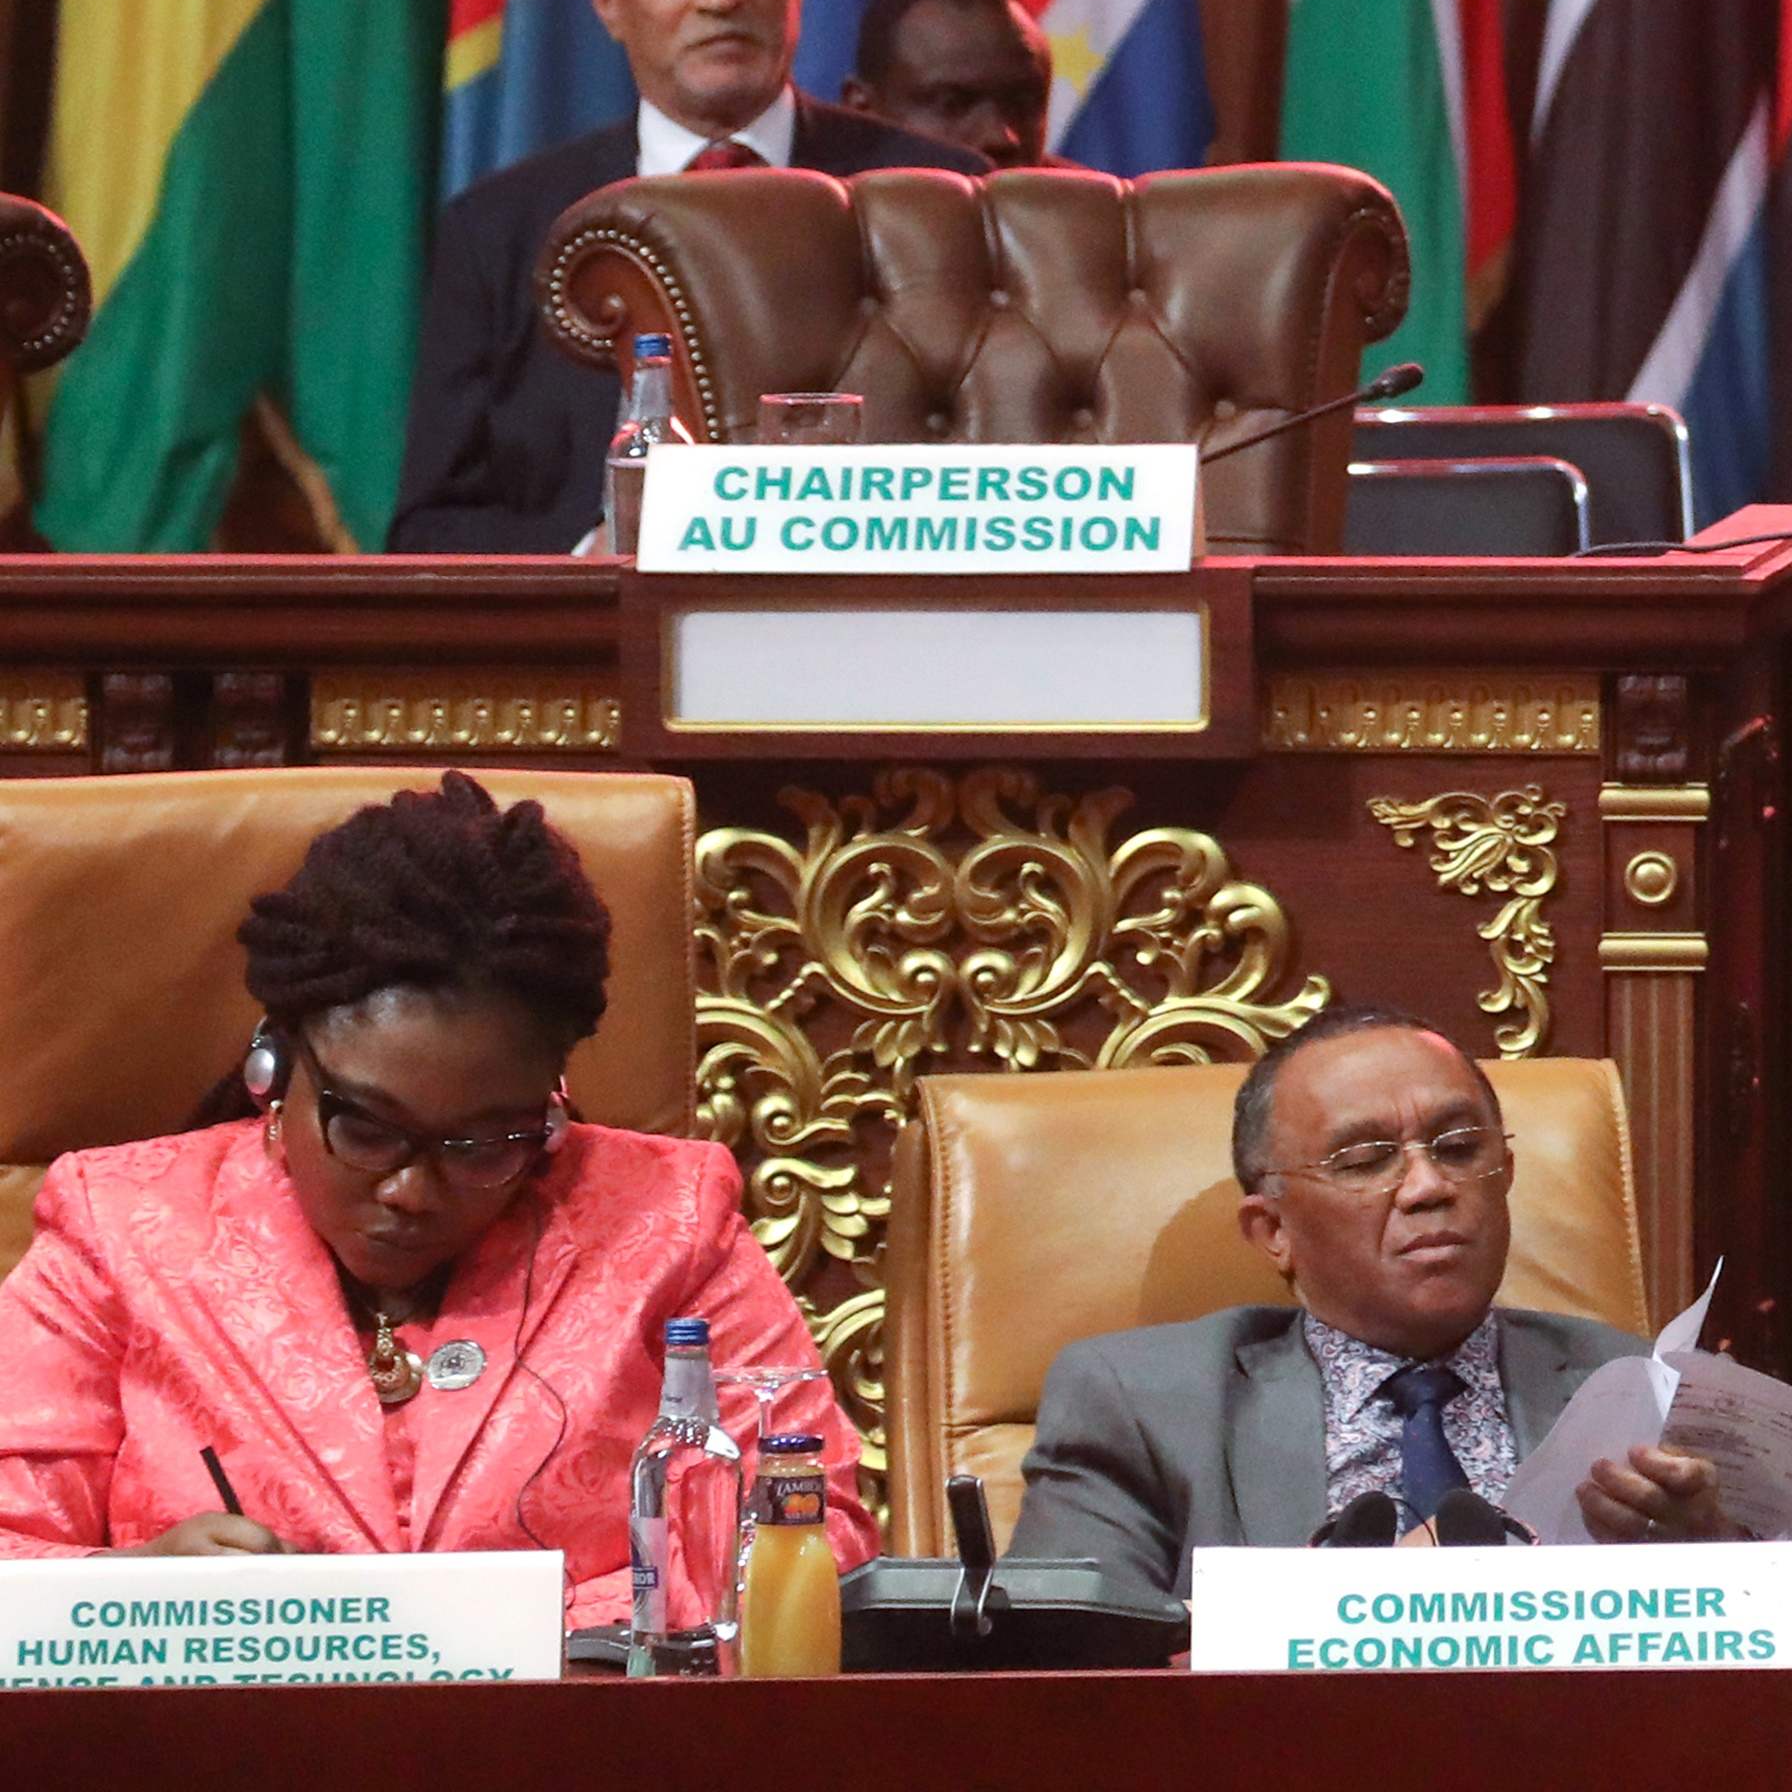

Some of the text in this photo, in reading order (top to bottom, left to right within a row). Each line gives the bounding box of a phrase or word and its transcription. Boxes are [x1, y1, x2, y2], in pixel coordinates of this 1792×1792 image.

[712, 466, 1136, 501] CHAIRPERSON
[678, 515, 1162, 553] AU COMMISSION
[70, 1597, 391, 1628] COMMISSIONER
[1337, 1587, 1727, 1625] COMMISSIONER
[17, 1634, 441, 1667] HUMAN RESOURCES,
[1287, 1629, 1777, 1670] ECONOMIC AFFAIRS
